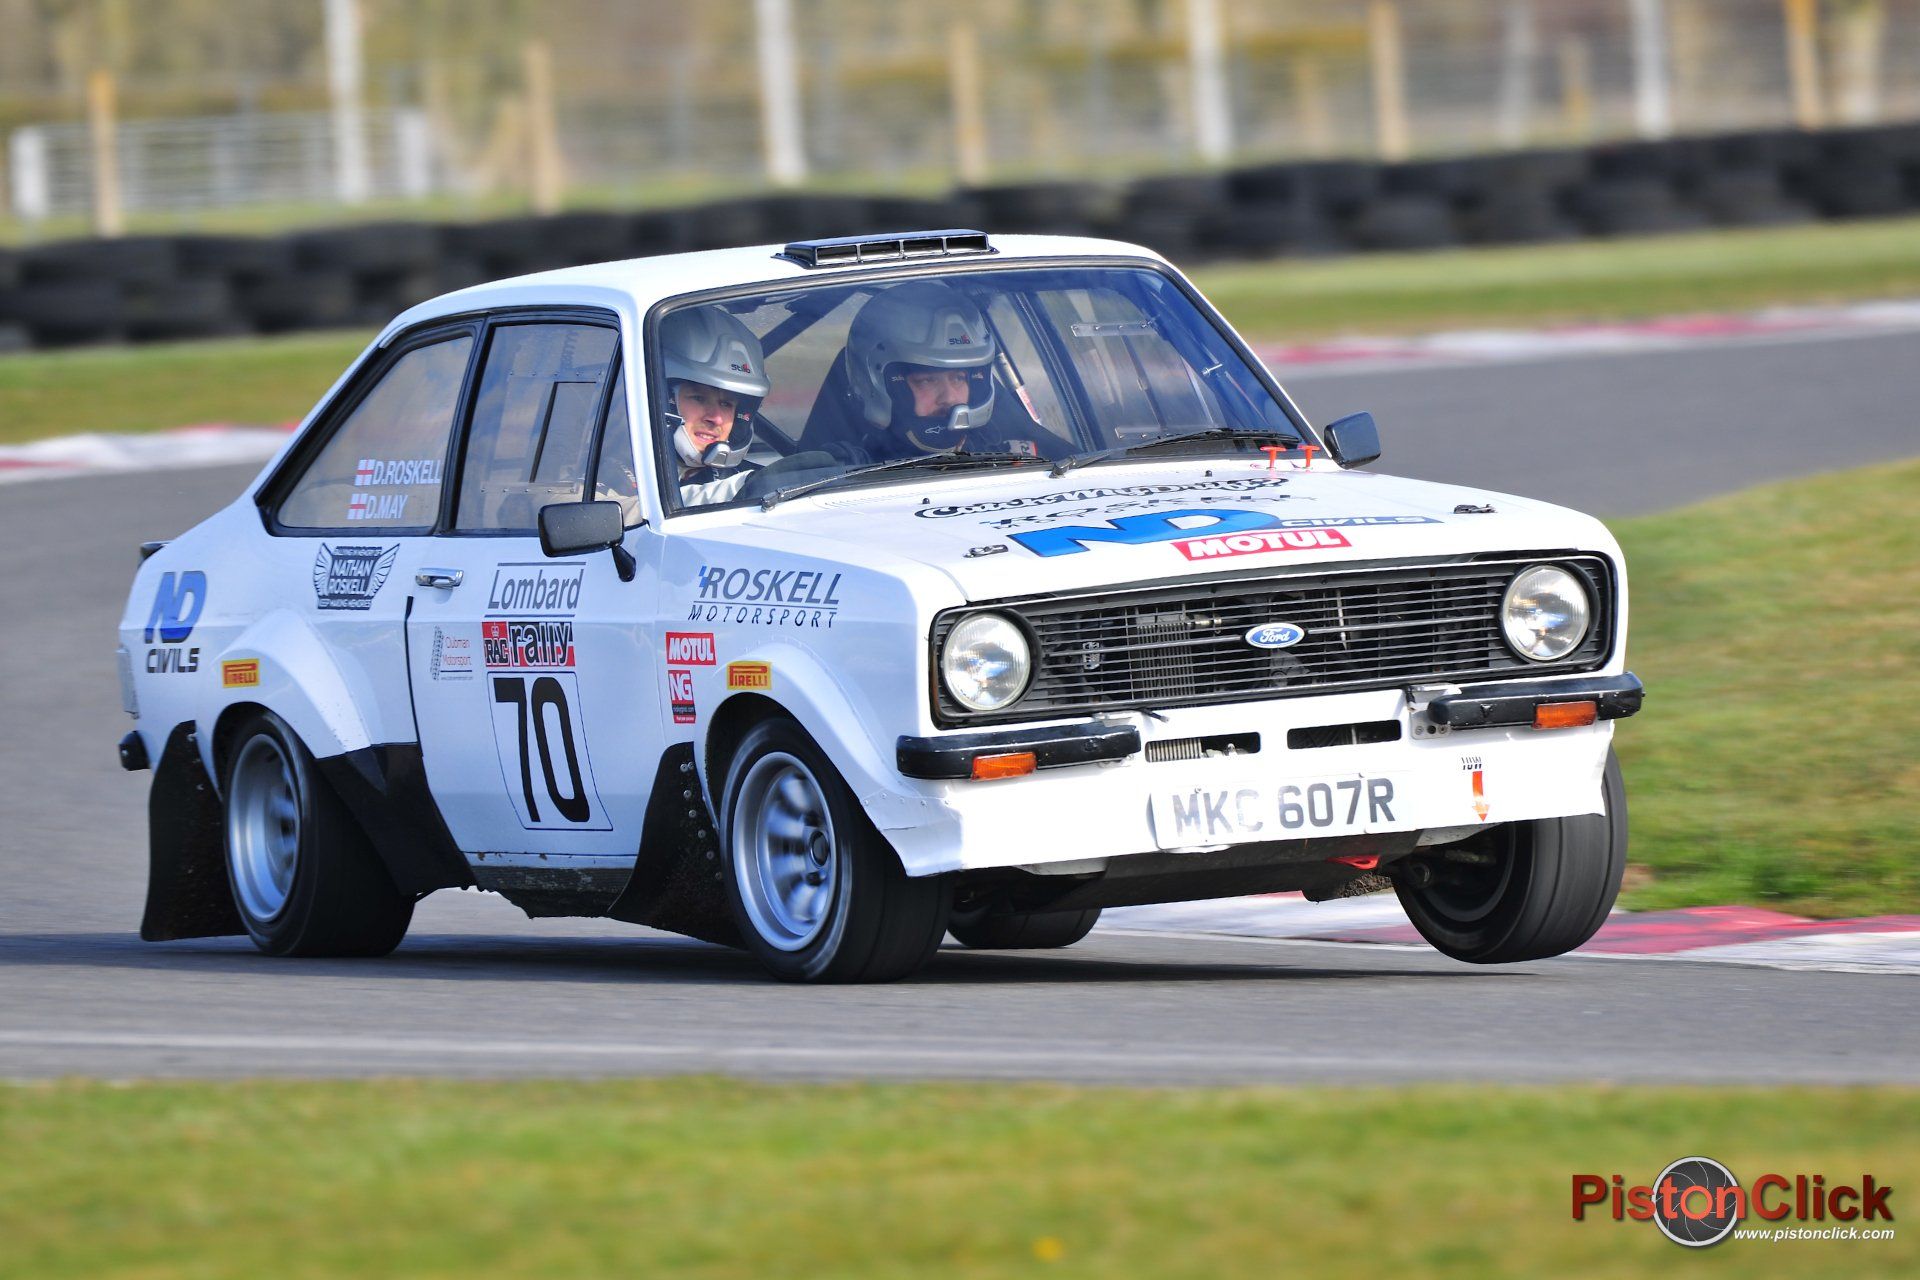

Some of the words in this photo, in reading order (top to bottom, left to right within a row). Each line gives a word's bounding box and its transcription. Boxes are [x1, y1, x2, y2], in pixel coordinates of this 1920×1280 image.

[372, 460, 440, 485] D.ROSKELL
[365, 494, 409, 519] D.MAY
[1281, 516, 1426, 528] CIVILS
[1187, 529, 1342, 558] MOTUL
[331, 560, 374, 576] NATHAN
[328, 578, 366, 594] ROSKELL
[488, 568, 584, 609] Lombard
[700, 567, 842, 604] ROSKELL
[144, 571, 206, 643] ND
[688, 605, 837, 628] MOTORSPORT
[485, 639, 510, 665] RAC
[510, 622, 570, 666] rally
[1260, 628, 1291, 643] Ford
[147, 648, 200, 673] CIVILS
[668, 637, 714, 662] MOTUL
[224, 663, 258, 685] PIRELLI
[729, 665, 768, 687] PIRELLI
[669, 673, 693, 701] NG
[493, 677, 590, 822] 70
[1172, 788, 1264, 837] MKC
[1278, 777, 1396, 829] 607R
